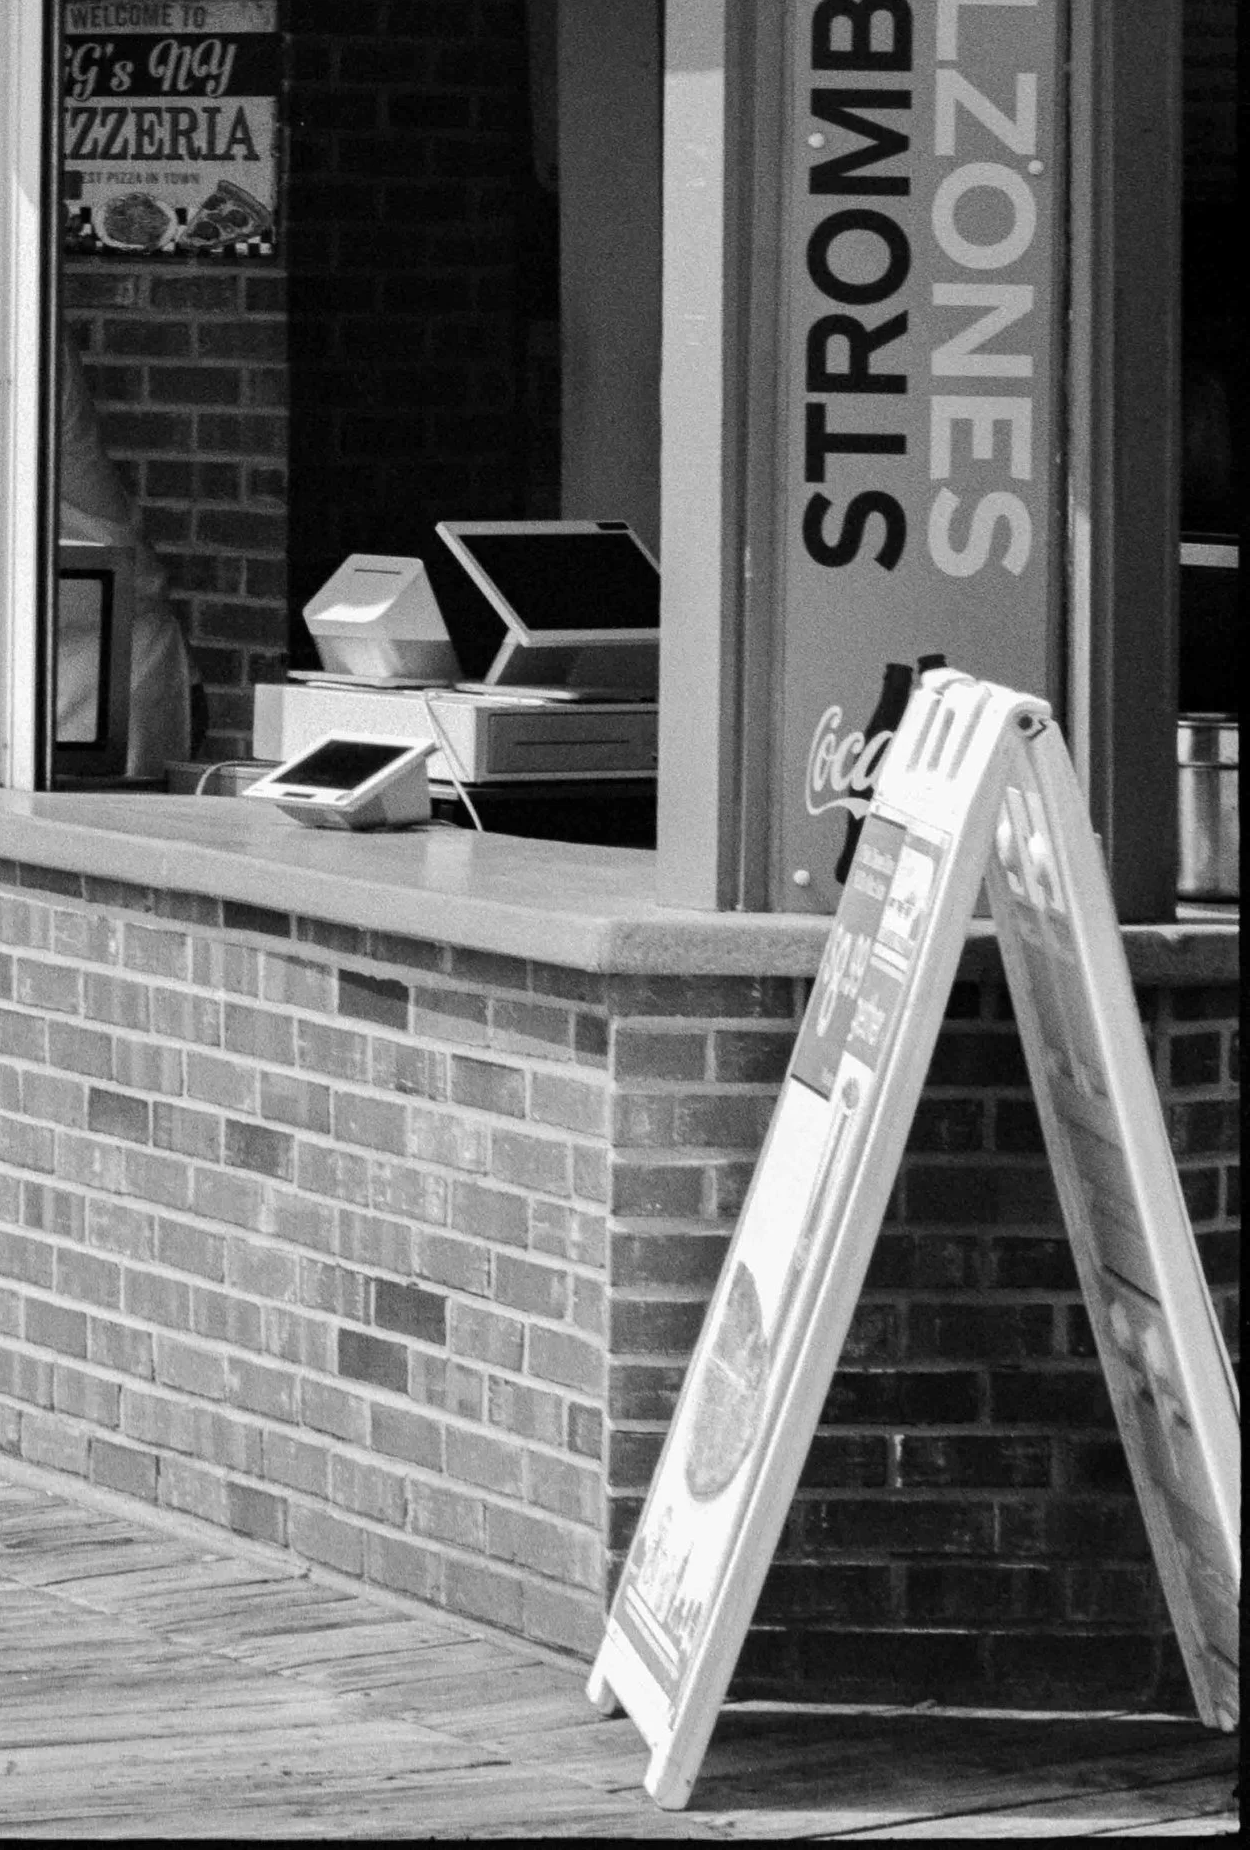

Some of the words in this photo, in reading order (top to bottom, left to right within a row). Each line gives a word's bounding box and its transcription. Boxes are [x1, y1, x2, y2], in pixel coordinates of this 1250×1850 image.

[70, 3, 174, 30] WELCOME
[182, 5, 207, 29] TO
[65, 105, 261, 161] ZZERIA
